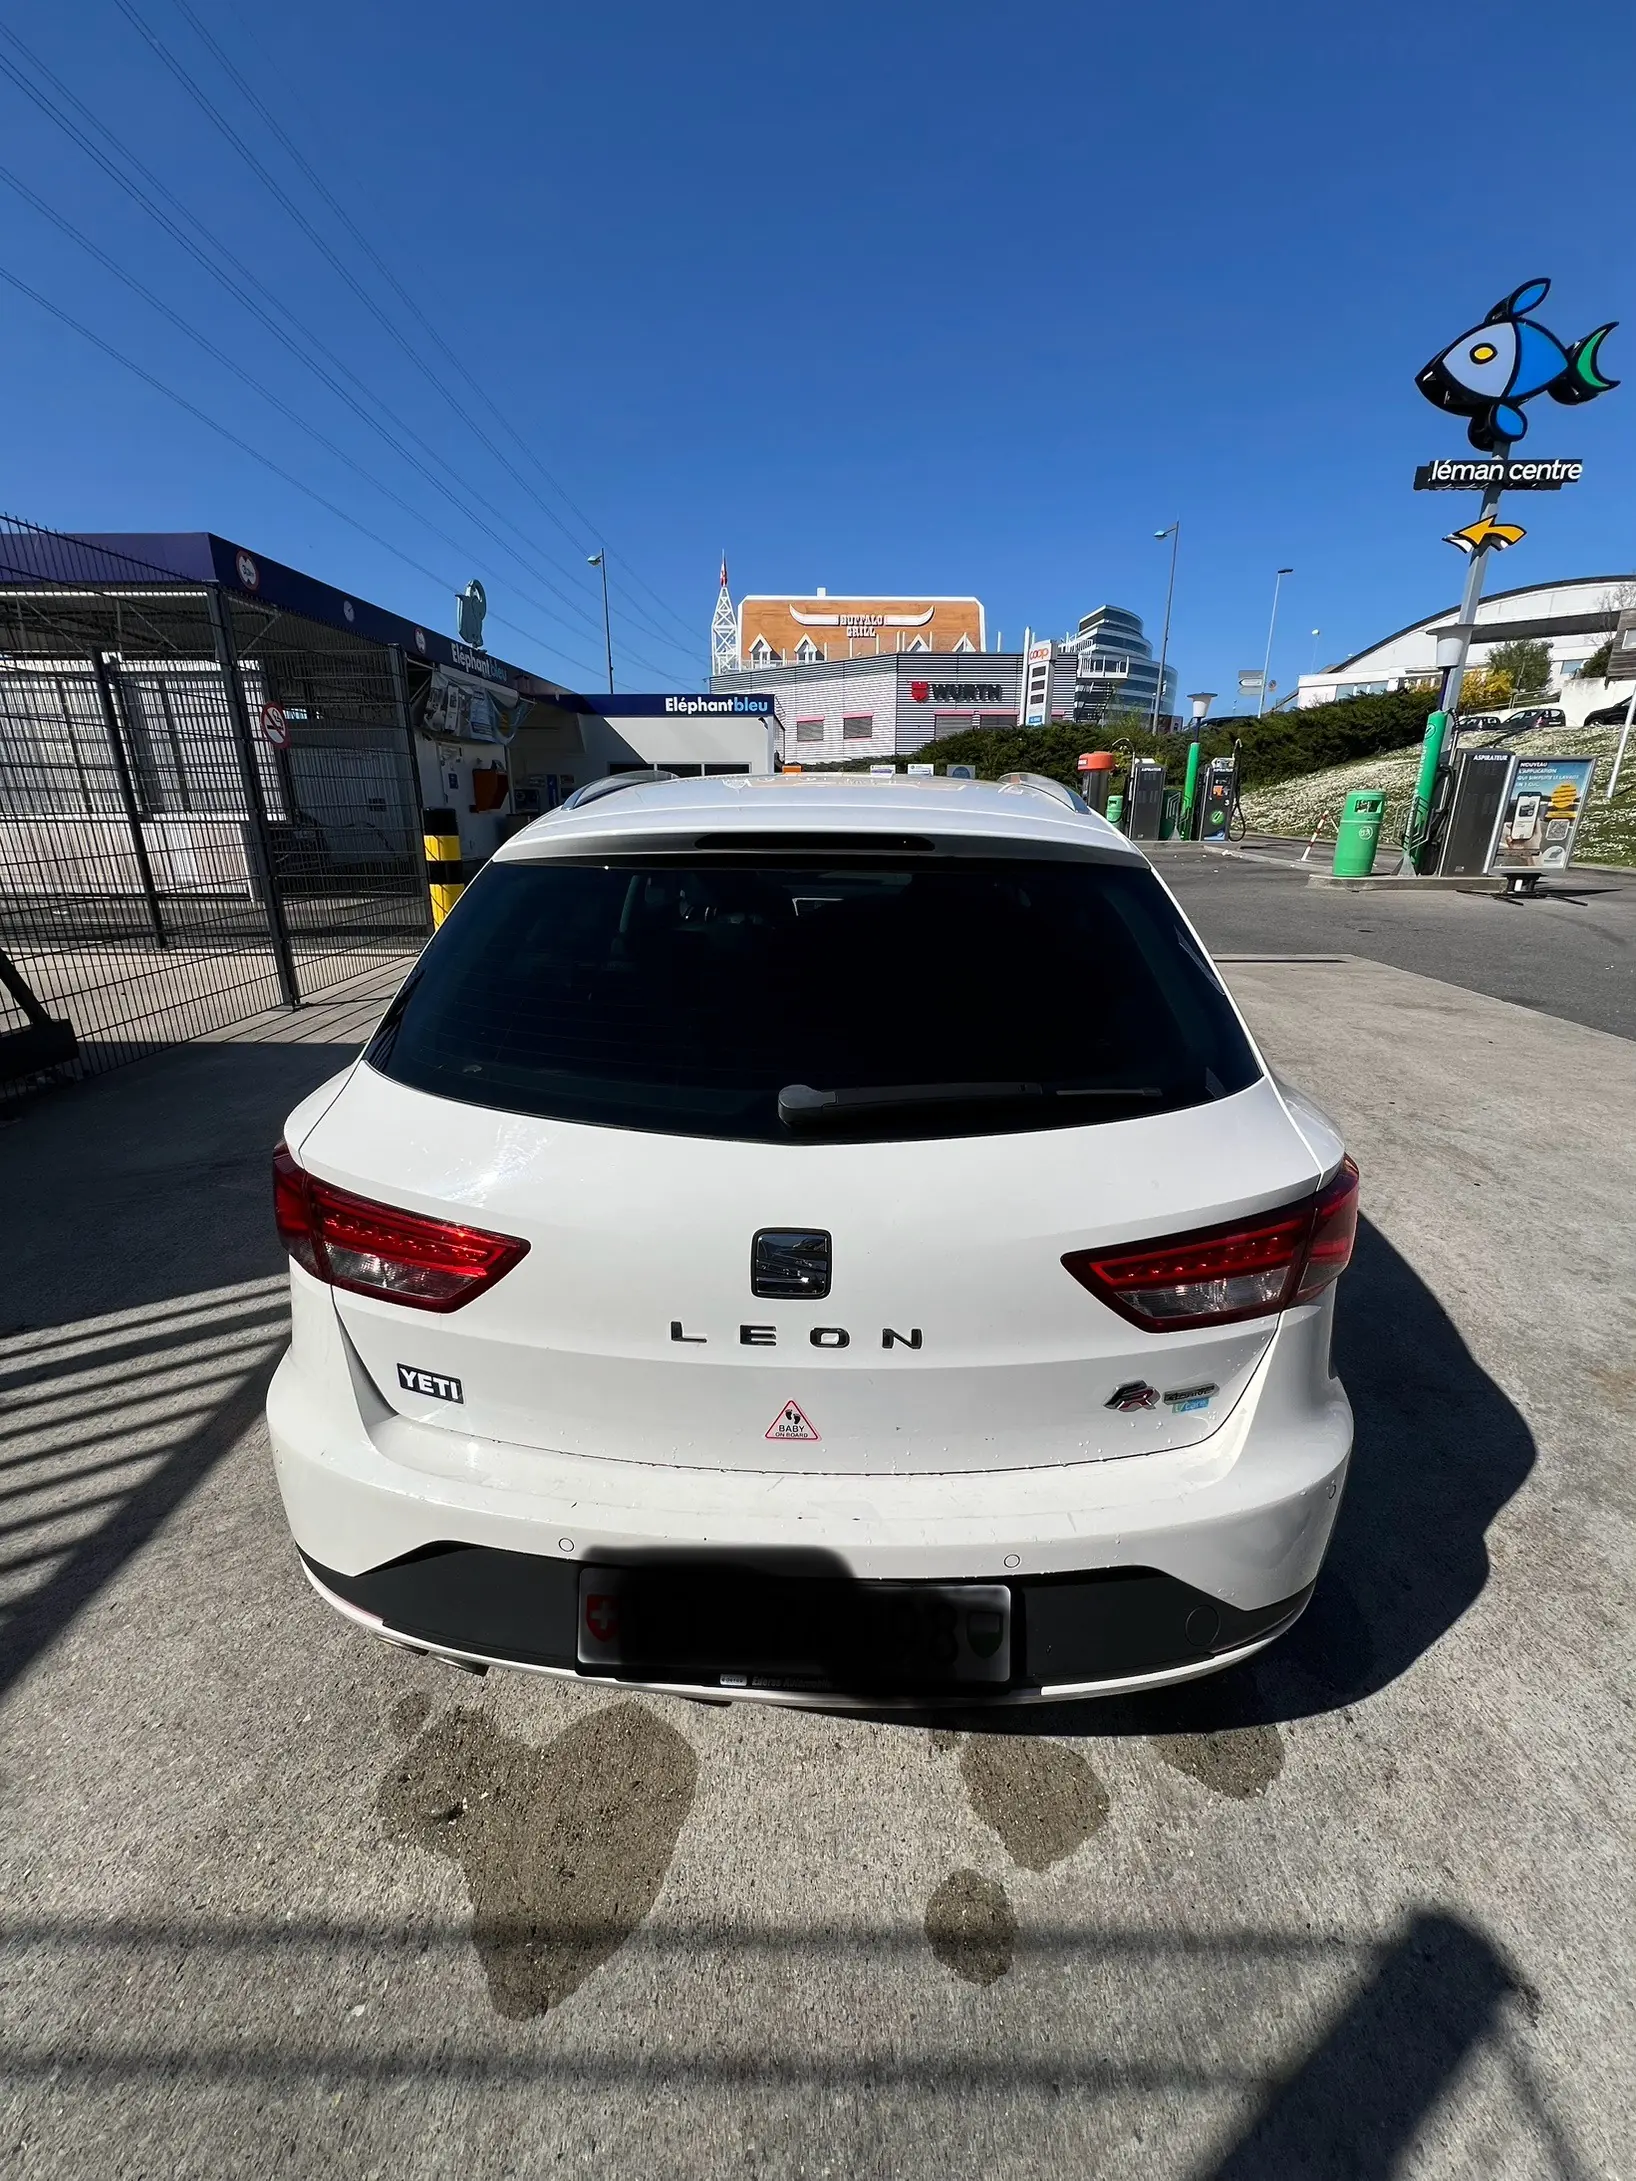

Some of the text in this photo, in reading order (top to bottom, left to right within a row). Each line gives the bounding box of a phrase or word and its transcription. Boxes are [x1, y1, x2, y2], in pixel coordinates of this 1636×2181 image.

[1431, 459, 1583, 480] léman centre
[840, 614, 883, 626] BUFFALO
[846, 626, 876, 637] GRILL
[1029, 648, 1049, 659] coop
[670, 1320, 922, 1350] LEON
[399, 1367, 459, 1400] YETI
[778, 1424, 805, 1433] BABY
